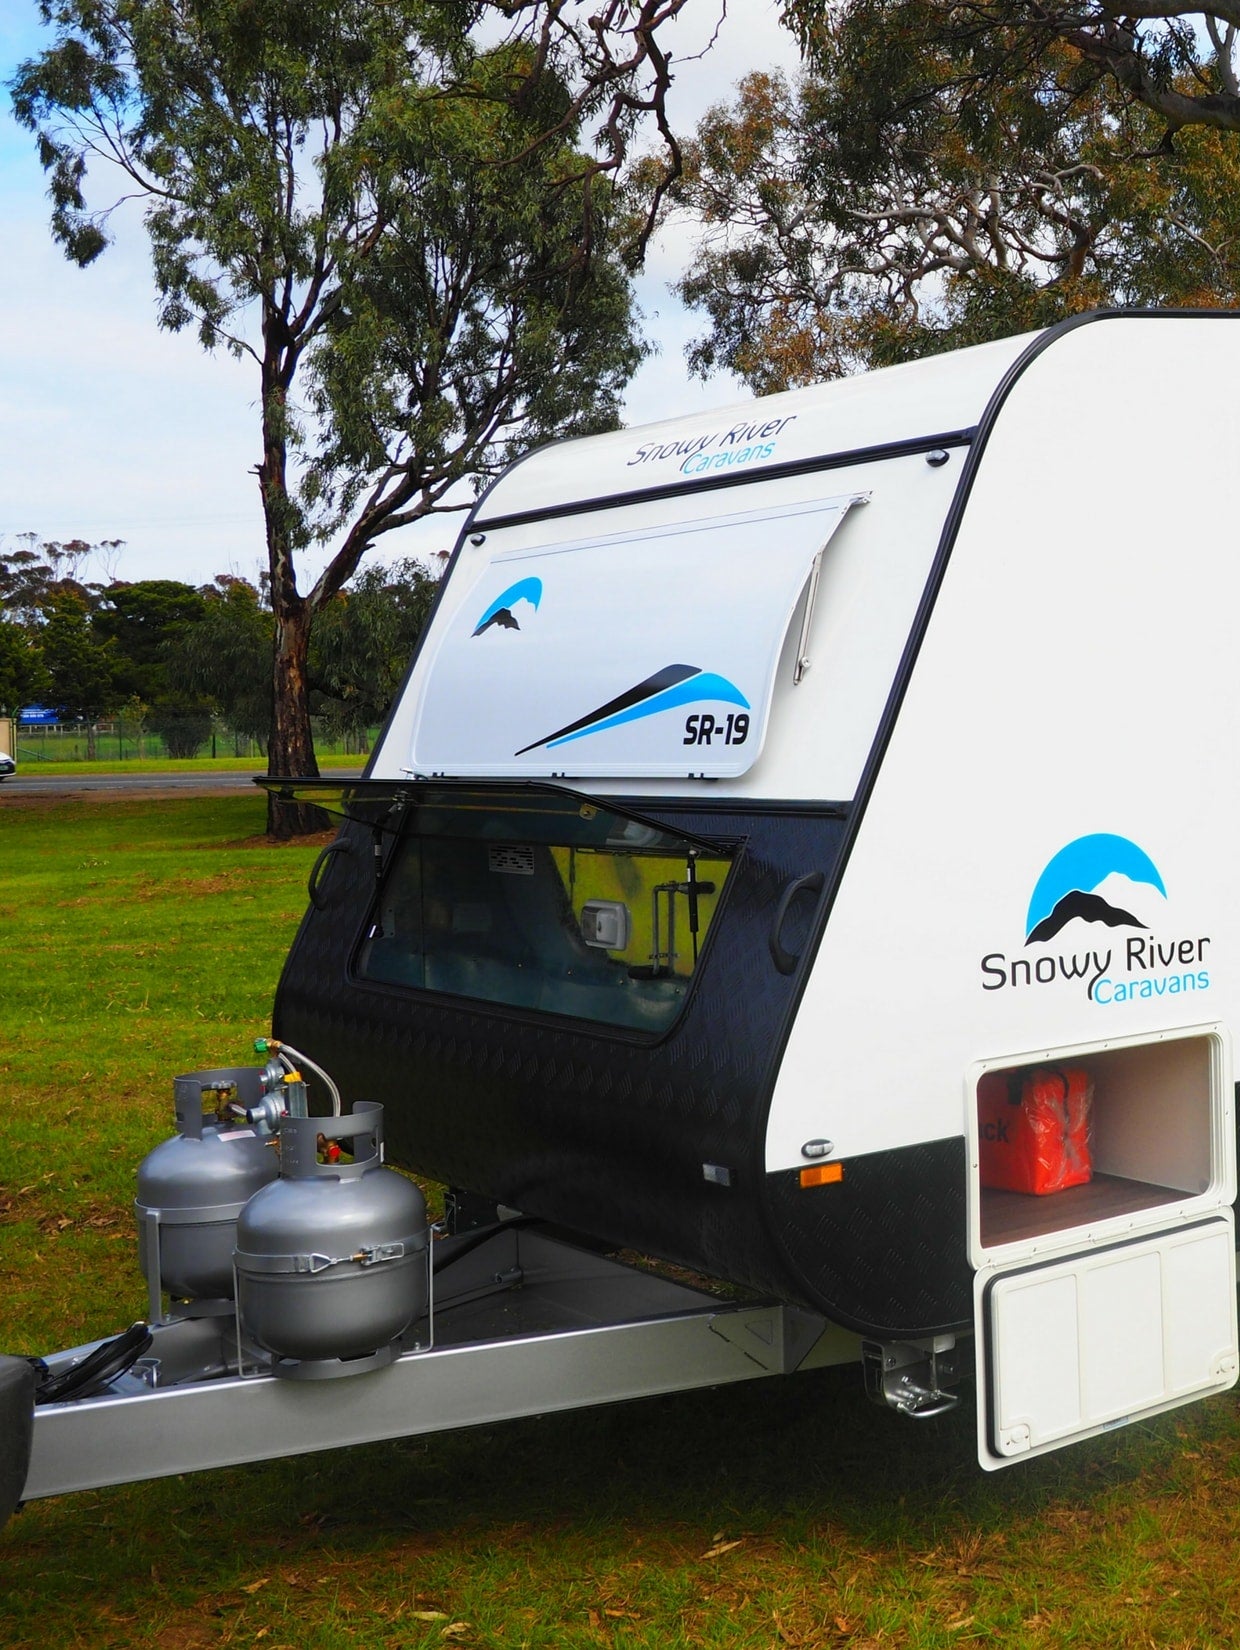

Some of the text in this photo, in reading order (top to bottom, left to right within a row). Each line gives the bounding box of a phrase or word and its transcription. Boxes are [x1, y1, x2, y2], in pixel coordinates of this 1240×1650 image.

[626, 415, 797, 472] Snowy River
[682, 441, 776, 475] Caravans
[682, 713, 750, 746] SR-19
[980, 935, 1211, 1001] Snowy River
[1093, 970, 1210, 1005] Caravans
